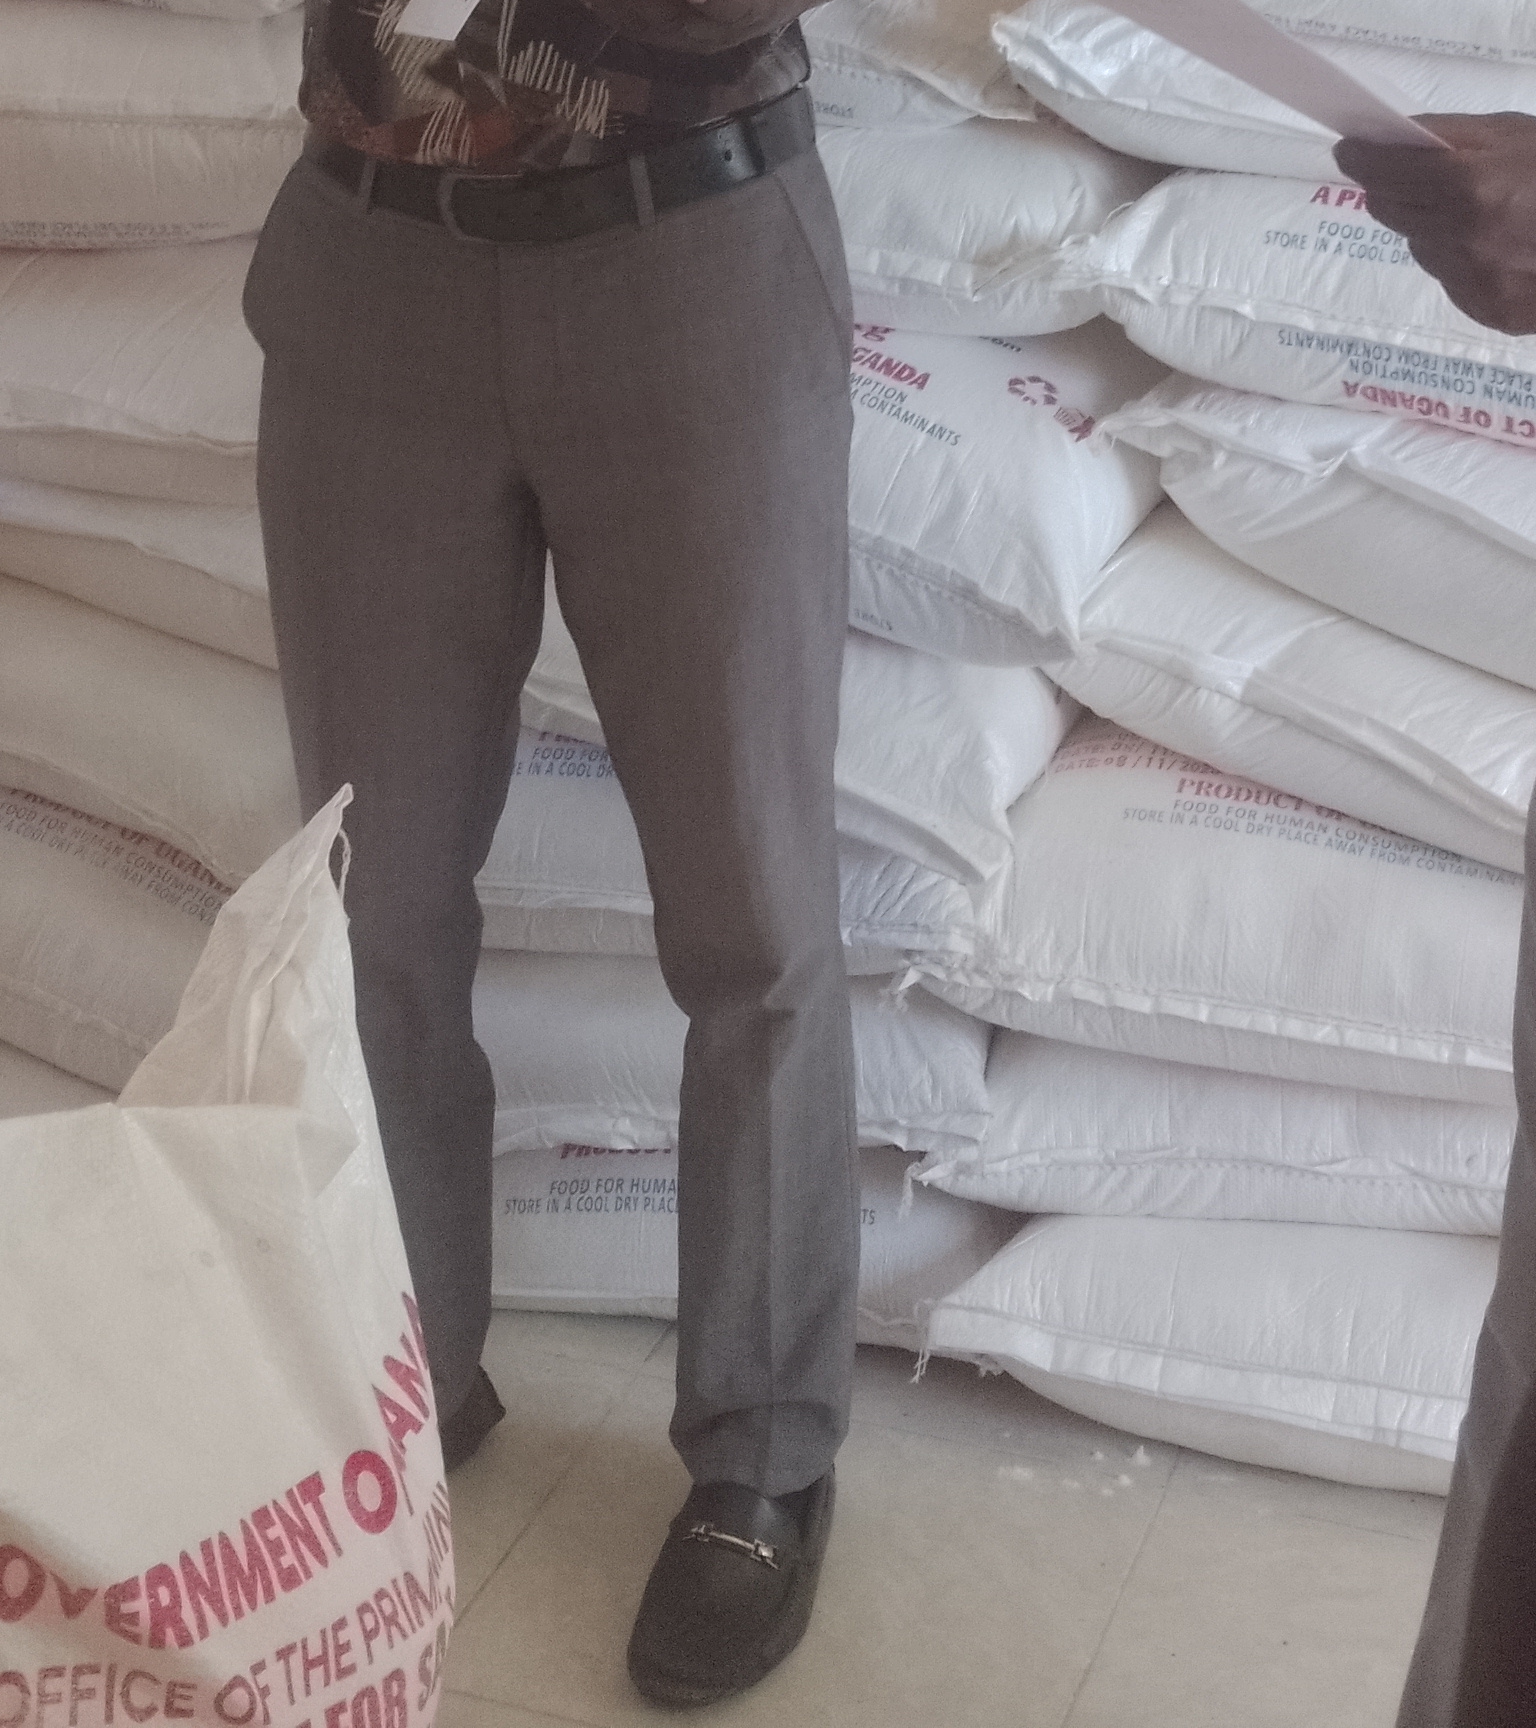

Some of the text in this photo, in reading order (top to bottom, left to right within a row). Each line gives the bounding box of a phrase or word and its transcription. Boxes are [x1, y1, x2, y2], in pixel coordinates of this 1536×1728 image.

[1310, 186, 1330, 204] A
[1264, 230, 1415, 267] STORE IN A COOL DR
[1318, 221, 1404, 248] FOOD FOR
[1276, 329, 1393, 363] CONTAMINANTS
[1397, 348, 1438, 372] FROM
[852, 346, 932, 391] GANDA
[1348, 358, 1476, 396] CONSUMPTION
[1443, 355, 1486, 382] AWAY
[1490, 365, 1533, 392] PLACE
[1340, 379, 1450, 421] UGANDA
[860, 393, 962, 447] CONTAMINANTS
[1456, 407, 1492, 430] OF
[532, 747, 575, 761] FOOD
[544, 761, 554, 776] A
[558, 762, 592, 778] COOL
[1175, 777, 1305, 812] PRODUCT
[1122, 807, 1165, 824] STORE
[1169, 811, 1185, 824] IN
[1189, 813, 1199, 825] A
[1204, 815, 1240, 833] COOL
[1245, 823, 1273, 838] DRY
[1277, 828, 1319, 846] PLACE
[1324, 837, 1365, 857] AWAY
[1173, 799, 1219, 815] FOOD
[1225, 805, 1257, 821] FOR
[1263, 812, 1329, 834] HUMAN
[1334, 827, 1462, 863] CONSUMPTION
[549, 1178, 679, 1195] FOOD FOR HUMA
[505, 1198, 542, 1216] STORE
[545, 1198, 560, 1214] IN
[576, 1195, 611, 1214] COOL
[614, 1195, 639, 1213] DRY
[642, 1196, 679, 1214] PLAC
[213, 1658, 271, 1728] OF
[275, 1616, 357, 1707] THE
